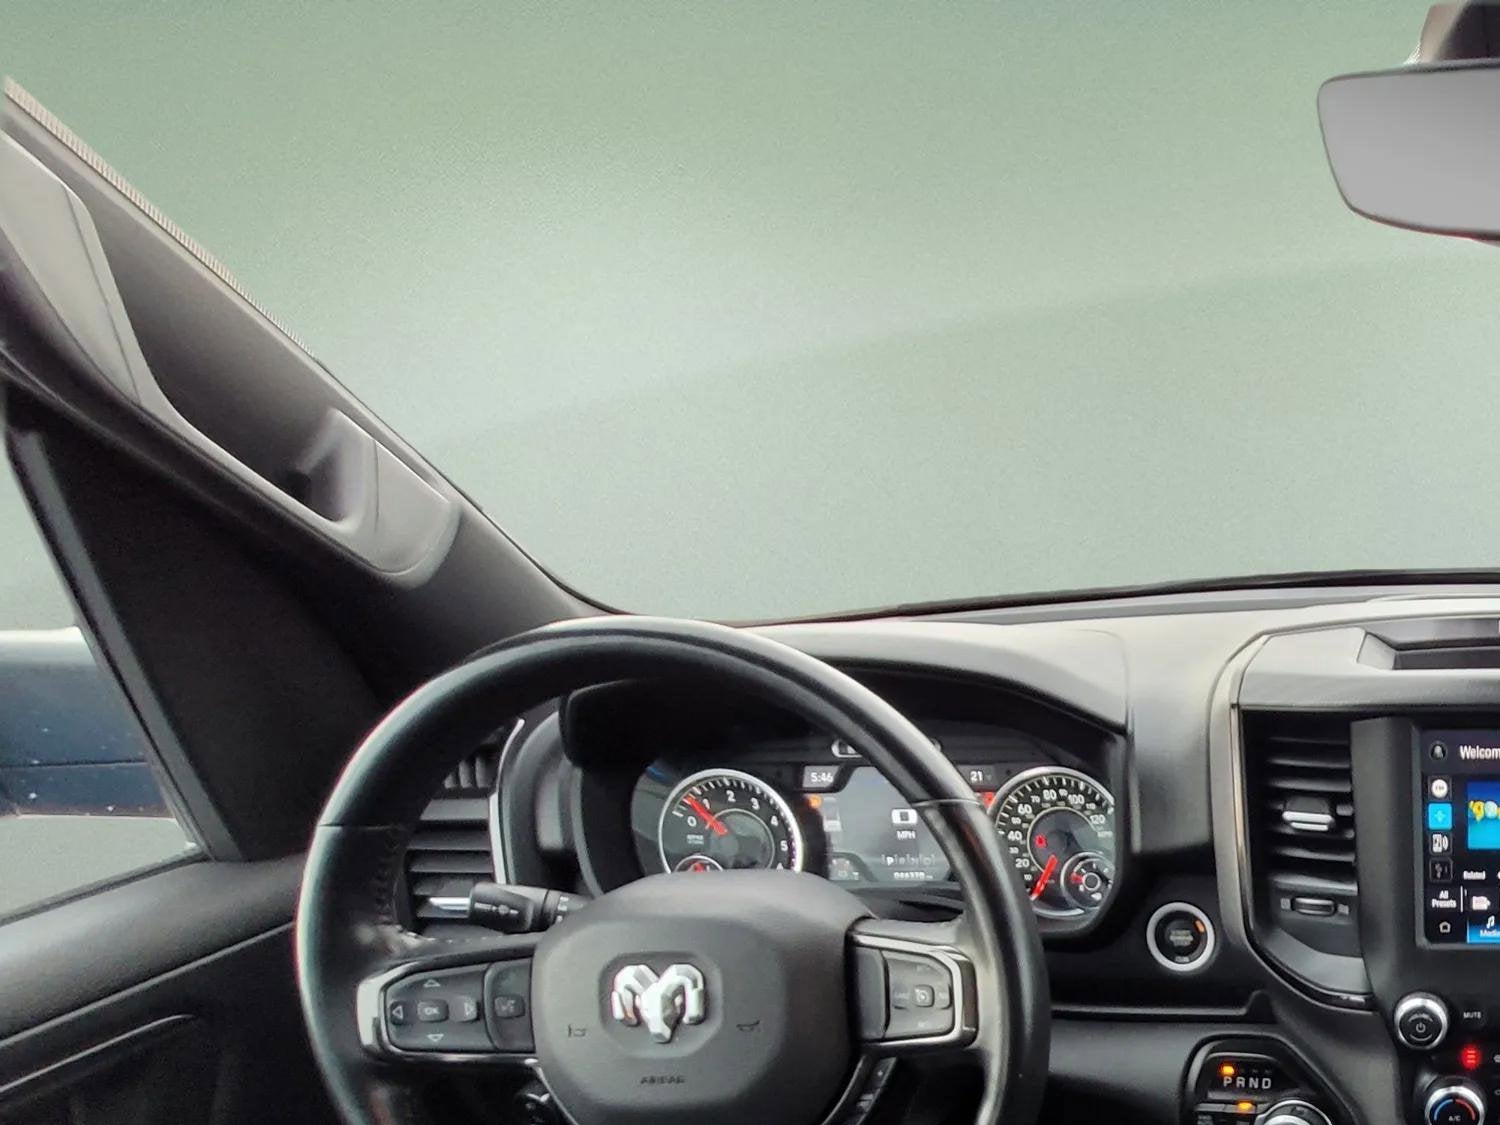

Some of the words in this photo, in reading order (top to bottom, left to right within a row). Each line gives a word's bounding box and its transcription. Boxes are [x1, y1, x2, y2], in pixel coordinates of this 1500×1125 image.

[810, 772, 834, 783] 5:46
[970, 770, 983, 782] 21
[726, 790, 737, 802] 2
[1043, 789, 1057, 800] 80
[1067, 794, 1085, 804] 100
[751, 797, 760, 810] 3
[1018, 804, 1032, 815] 60
[770, 815, 779, 827] 4
[1090, 814, 1106, 825] 120
[1007, 831, 1022, 841] 40
[780, 840, 789, 851] 5
[1015, 858, 1030, 868] 20
[1439, 890, 1449, 899] All
[1431, 899, 1457, 908] Presets
[1463, 1011, 1482, 1019] MUTE
